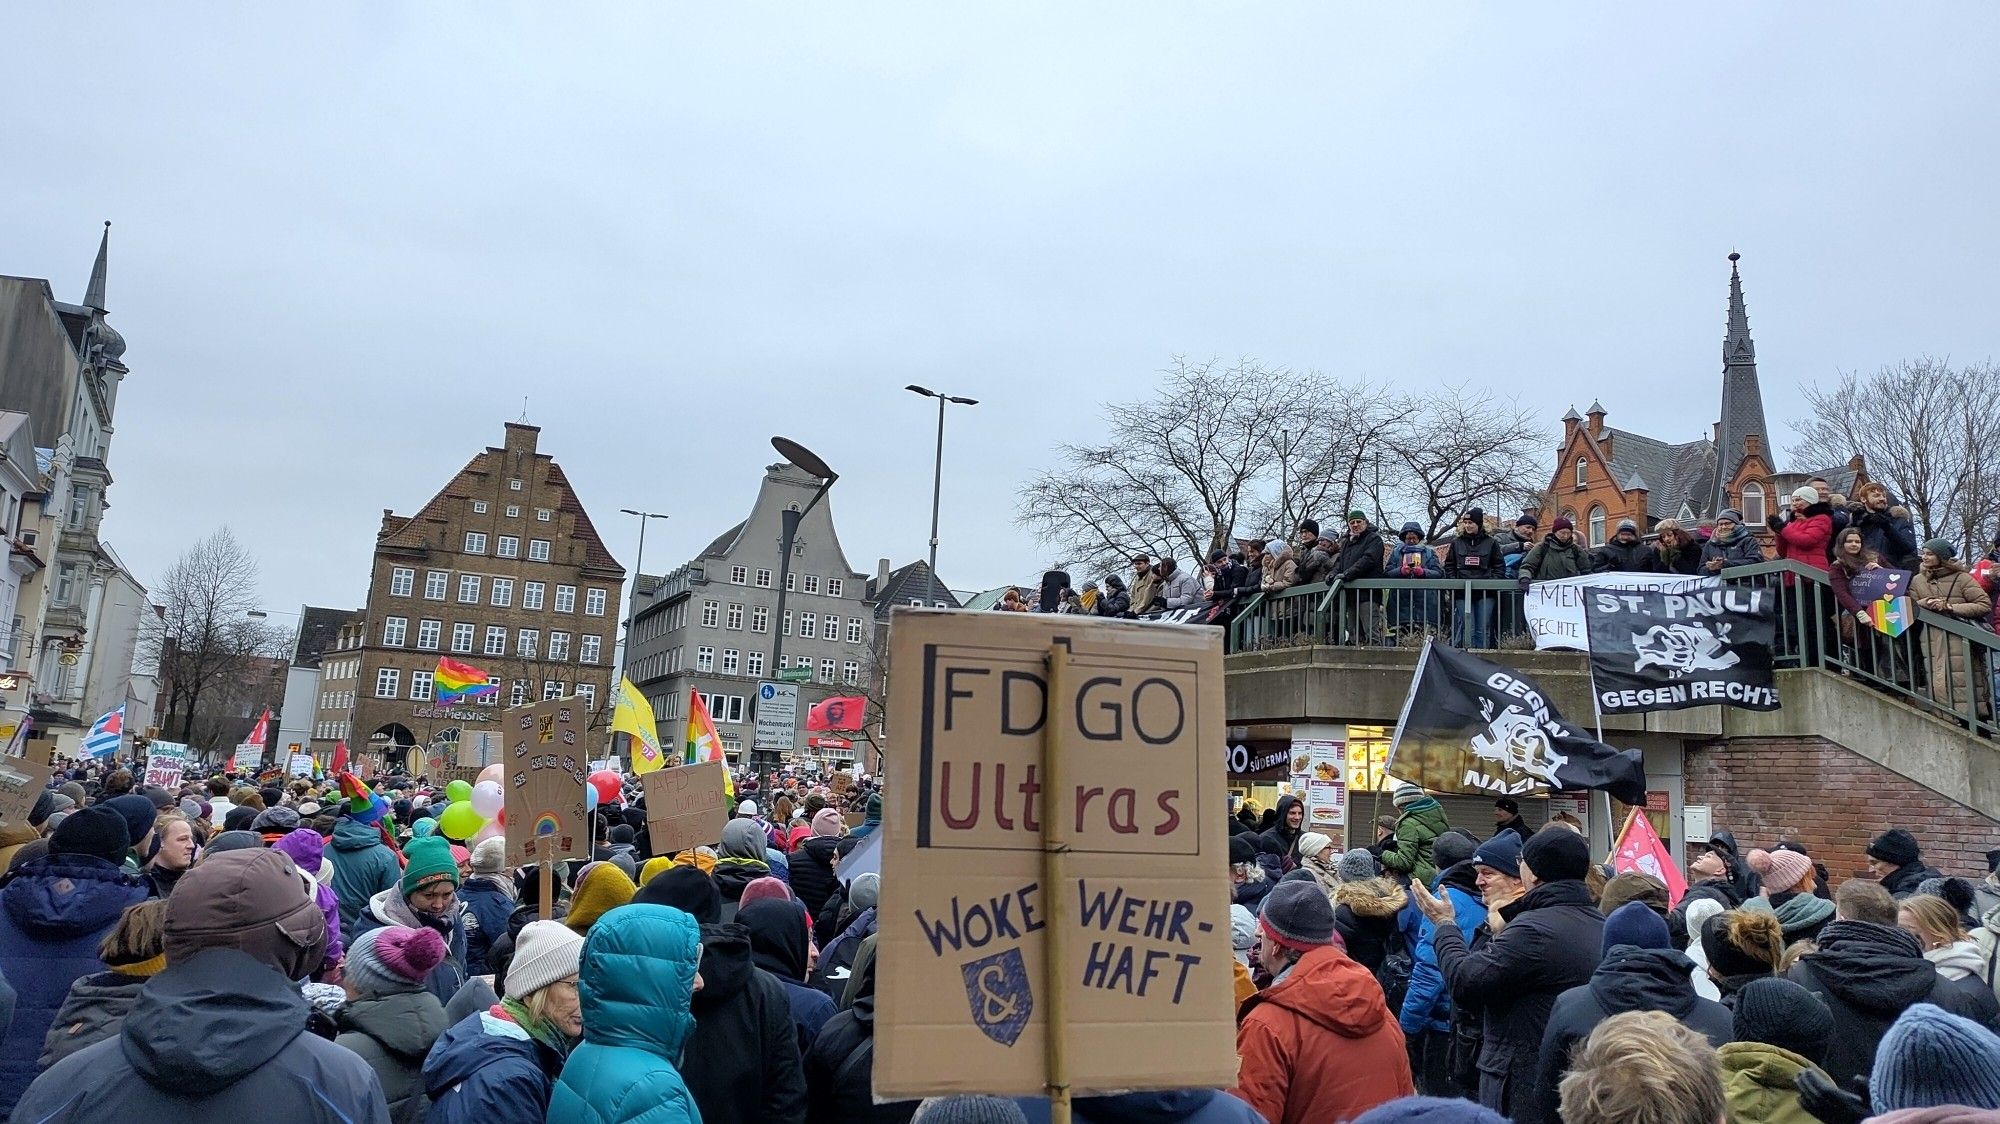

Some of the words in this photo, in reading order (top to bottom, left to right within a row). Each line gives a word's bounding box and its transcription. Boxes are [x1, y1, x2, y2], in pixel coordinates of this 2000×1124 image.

[1596, 593, 1651, 616] ST.
[1665, 590, 1762, 619] PAULI
[1529, 617, 1579, 638] RECHTE
[1487, 672, 1571, 738] GEGEN
[1601, 685, 1687, 708] GEGEN
[758, 719, 794, 729] Wochenmarkt
[146, 769, 183, 788] BUNT
[437, 771, 475, 781] RECHTE
[914, 882, 1047, 958] WOKE
[1078, 879, 1214, 946] WEHR-
[1082, 941, 1202, 1005] HAFT
[976, 964, 1018, 1025] &
